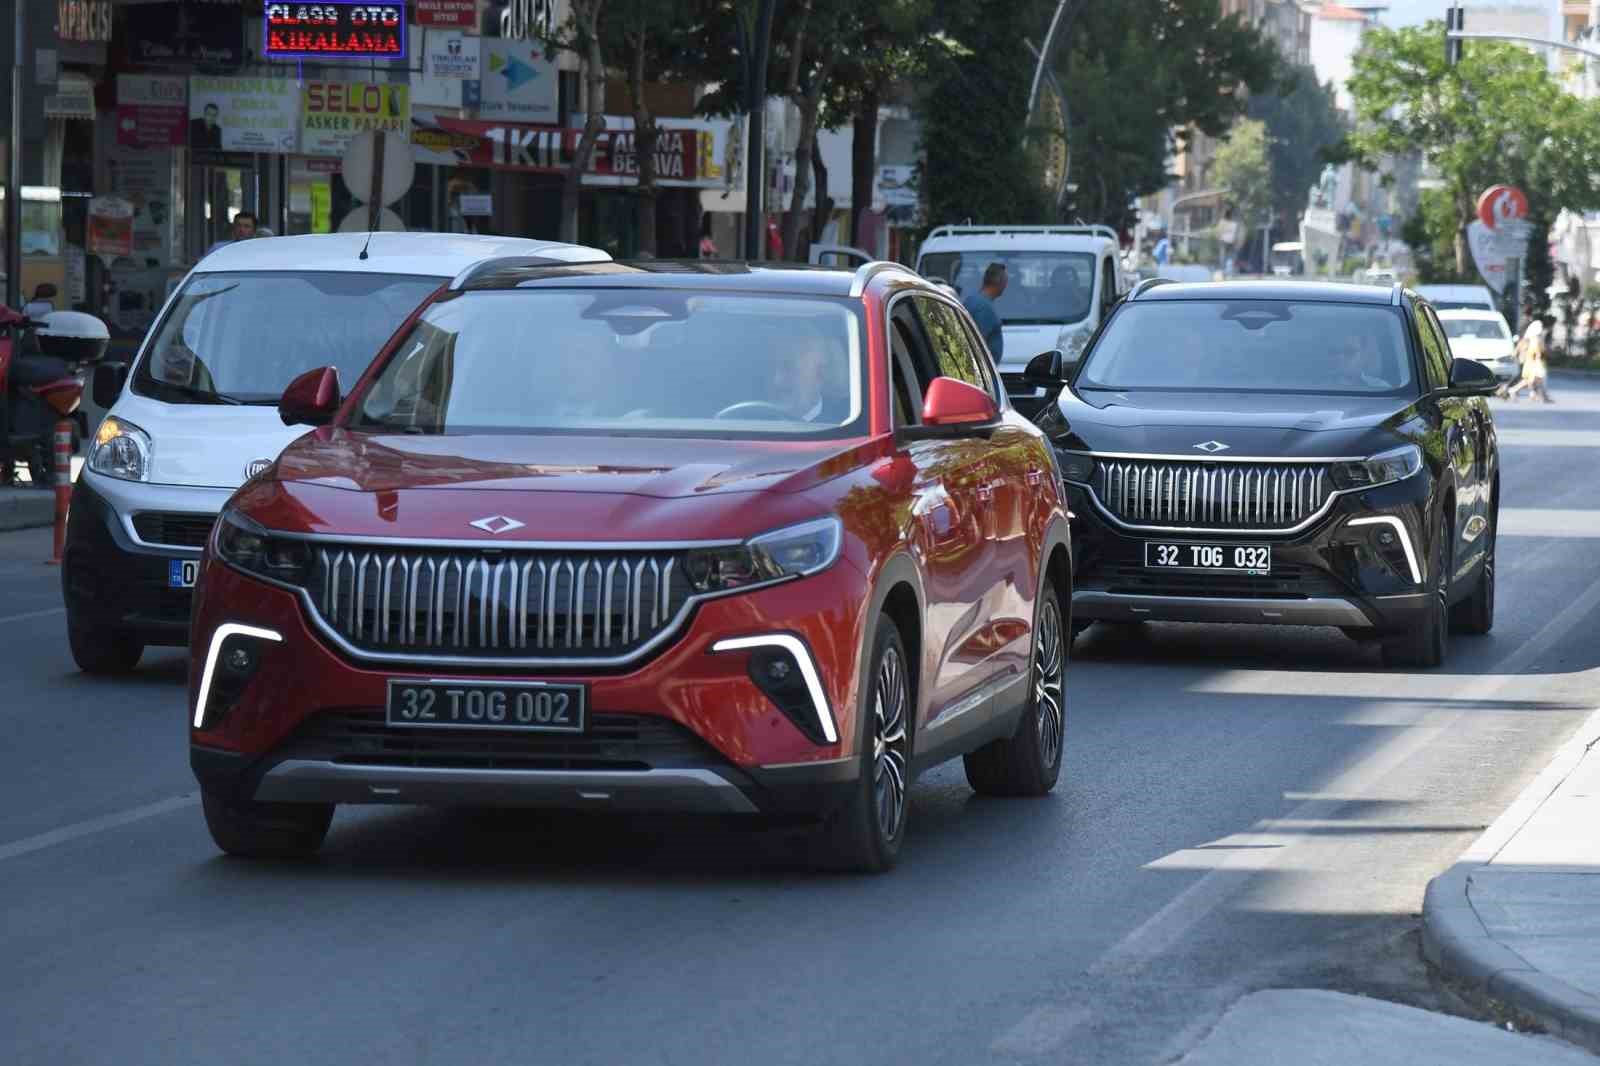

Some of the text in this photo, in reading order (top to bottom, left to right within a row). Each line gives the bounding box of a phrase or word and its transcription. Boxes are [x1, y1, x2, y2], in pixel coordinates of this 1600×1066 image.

[269, 4, 398, 26] CLASS OTO
[270, 31, 399, 51] KIRALAMA
[308, 84, 380, 112] SELO
[305, 115, 351, 129] ASKER
[613, 131, 684, 153] ALNA
[613, 153, 684, 175] BEAVA
[1157, 545, 1268, 568] 32 TOG 032
[401, 688, 569, 723] 32 TOG 002
